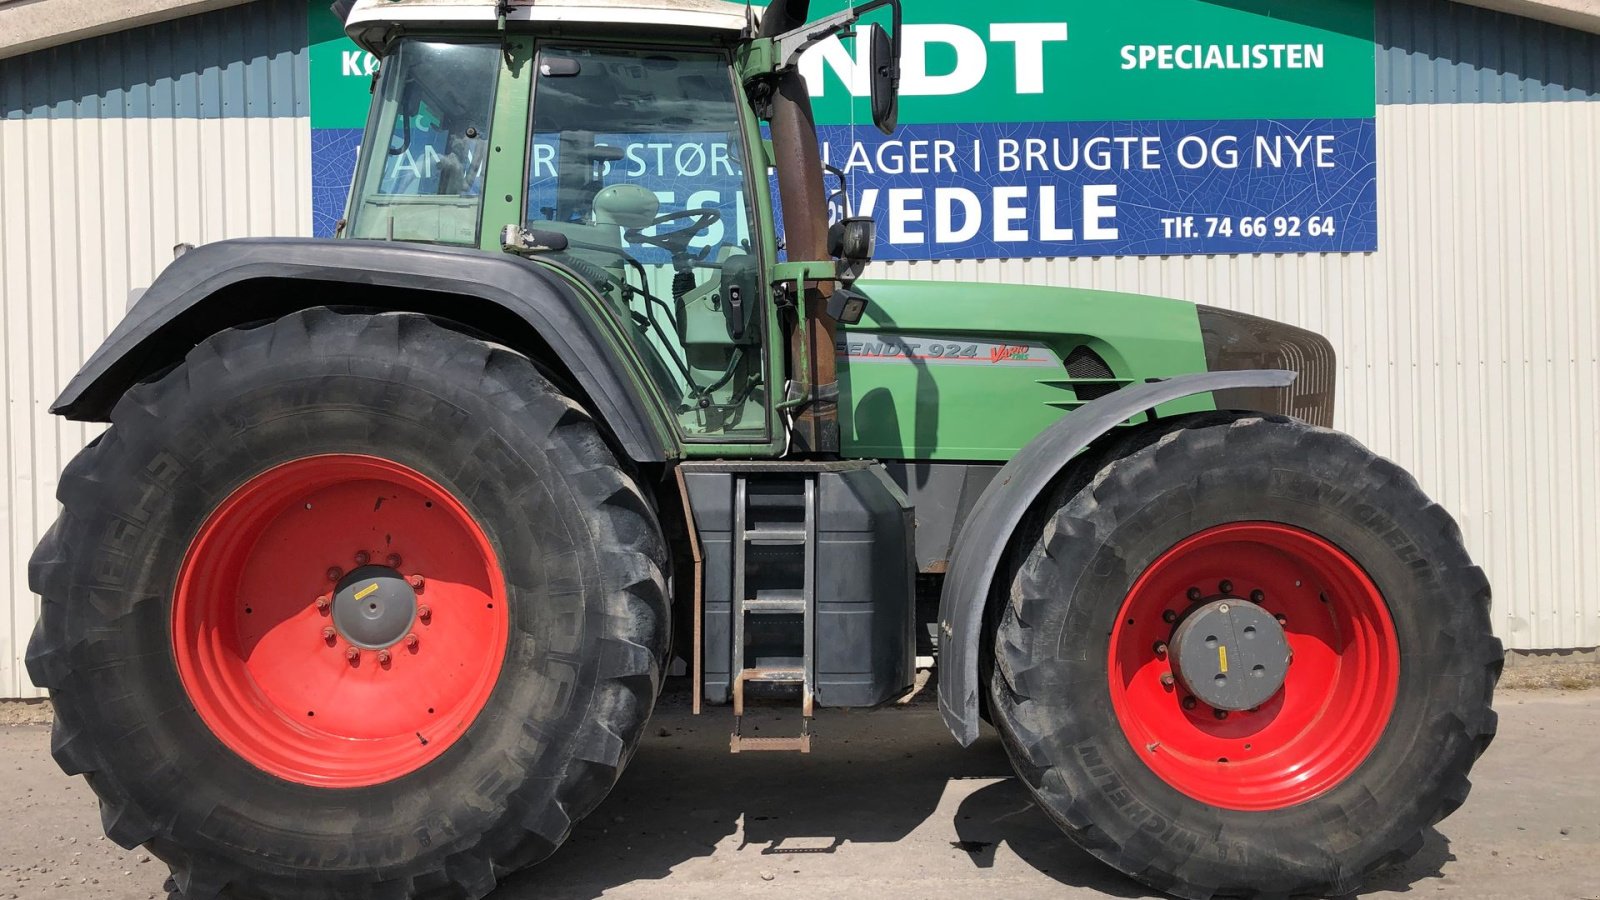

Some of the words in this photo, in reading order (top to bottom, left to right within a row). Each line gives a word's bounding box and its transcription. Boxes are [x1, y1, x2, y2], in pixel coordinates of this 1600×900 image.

[798, 22, 1068, 97] NDT
[1120, 44, 1324, 70] SPECIALISTEN
[823, 140, 958, 174] LAGER
[974, 139, 980, 172] I
[999, 136, 1161, 173] BRUGTE
[1177, 135, 1238, 169] OG
[1256, 135, 1335, 168] NYE
[1161, 216, 1199, 239] Tlf.
[1205, 217, 1233, 238] 74
[1239, 216, 1267, 237] 66
[1273, 216, 1301, 237] 92
[1307, 216, 1336, 237] 64
[927, 344, 978, 359] 924
[1077, 745, 1200, 852] MICHELIN
